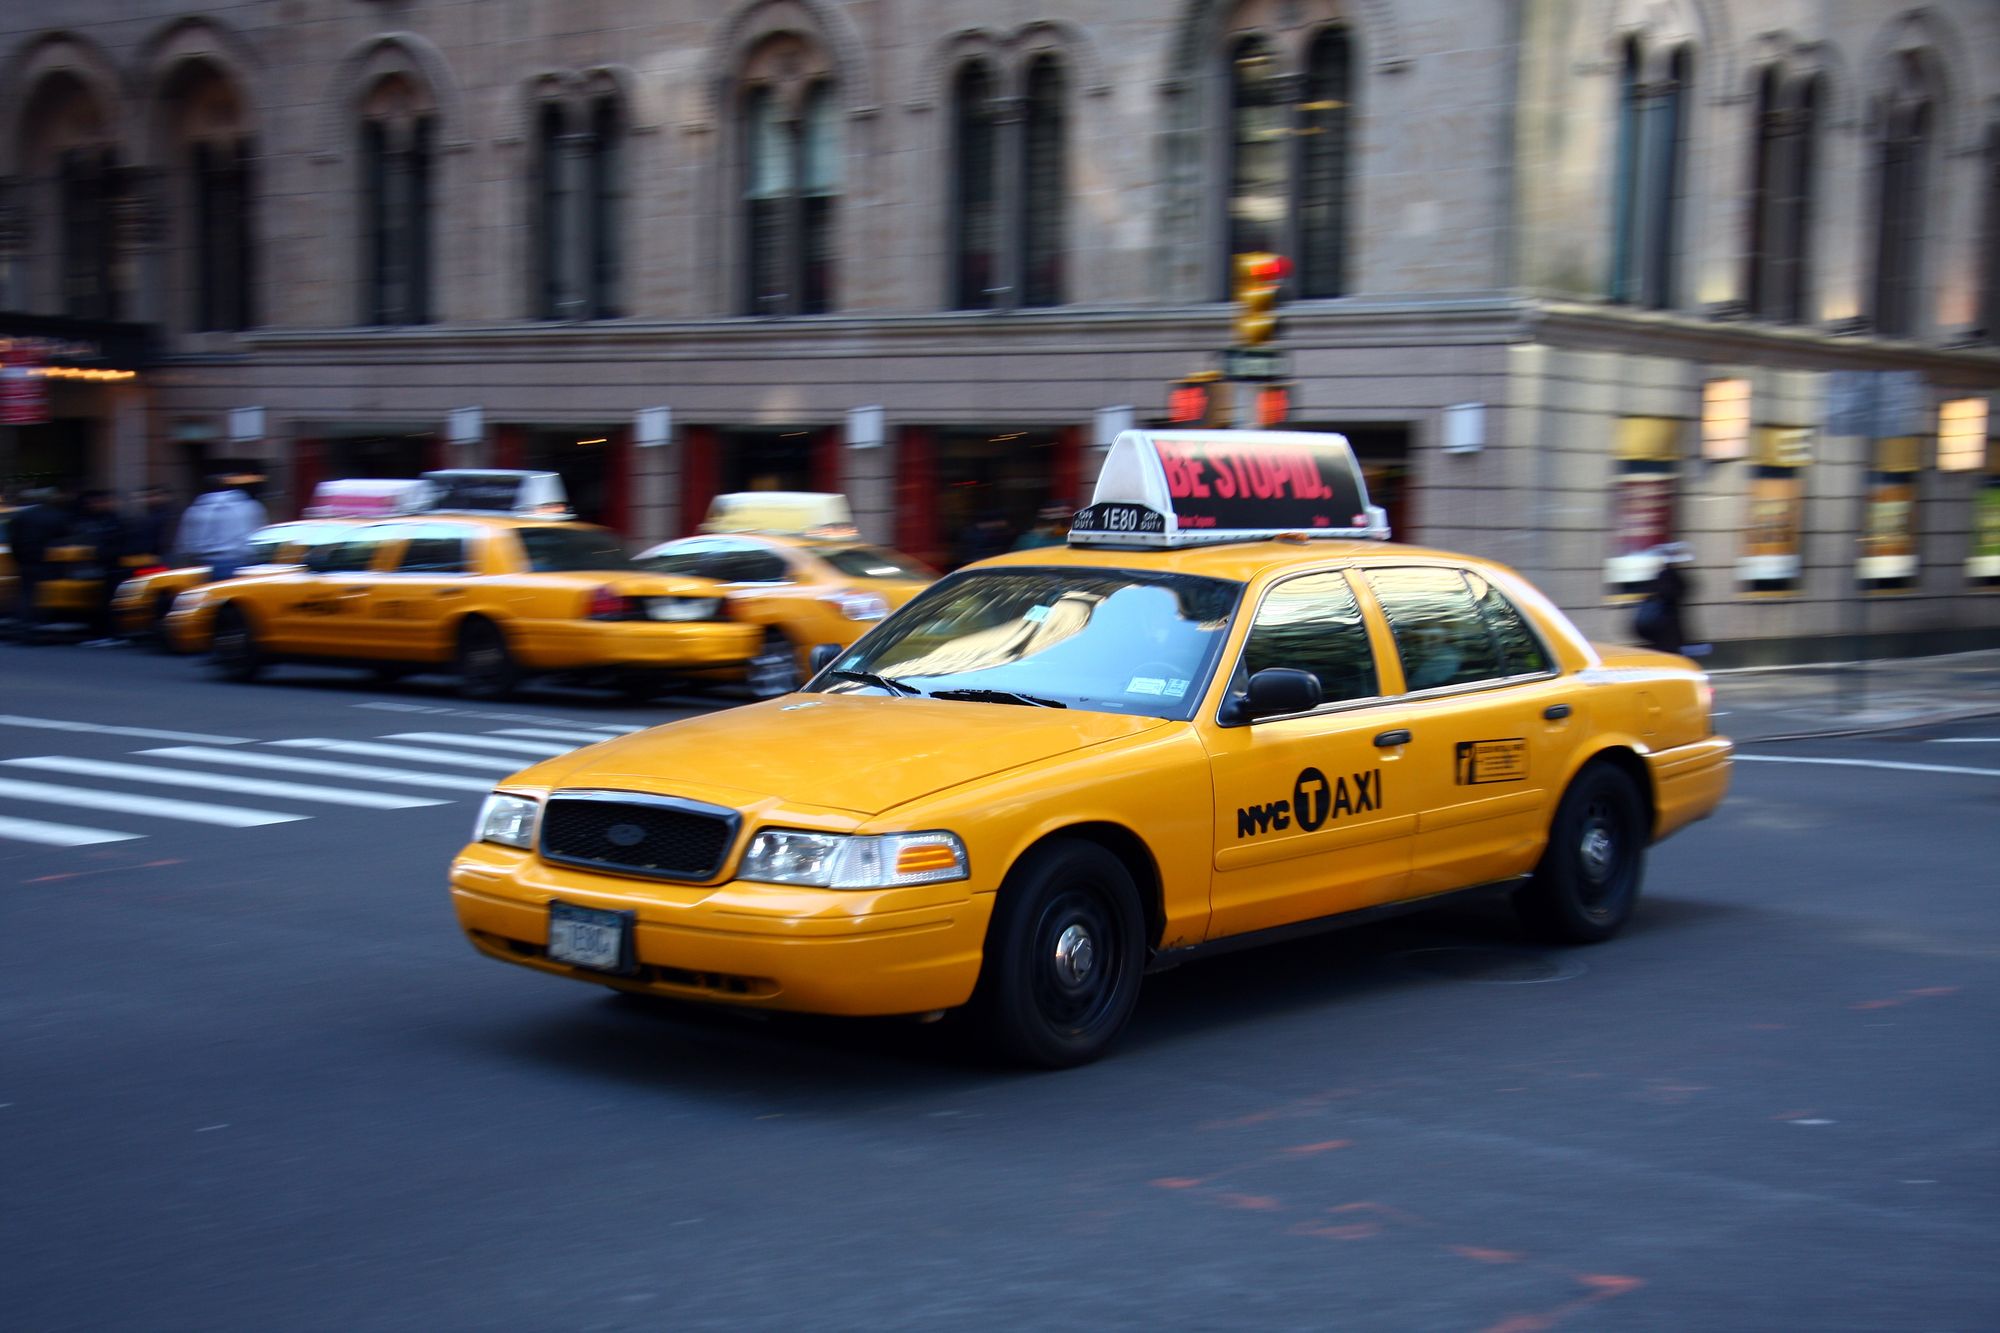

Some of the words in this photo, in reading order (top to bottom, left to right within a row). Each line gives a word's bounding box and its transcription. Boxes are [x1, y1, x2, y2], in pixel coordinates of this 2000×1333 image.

[1158, 441, 1211, 498] BE
[1075, 519, 1095, 529] DUTY
[1102, 507, 1138, 531] 1E80
[1141, 520, 1162, 531] DUTY
[1237, 799, 1291, 838] NYC
[1296, 768, 1383, 828] TAXI
